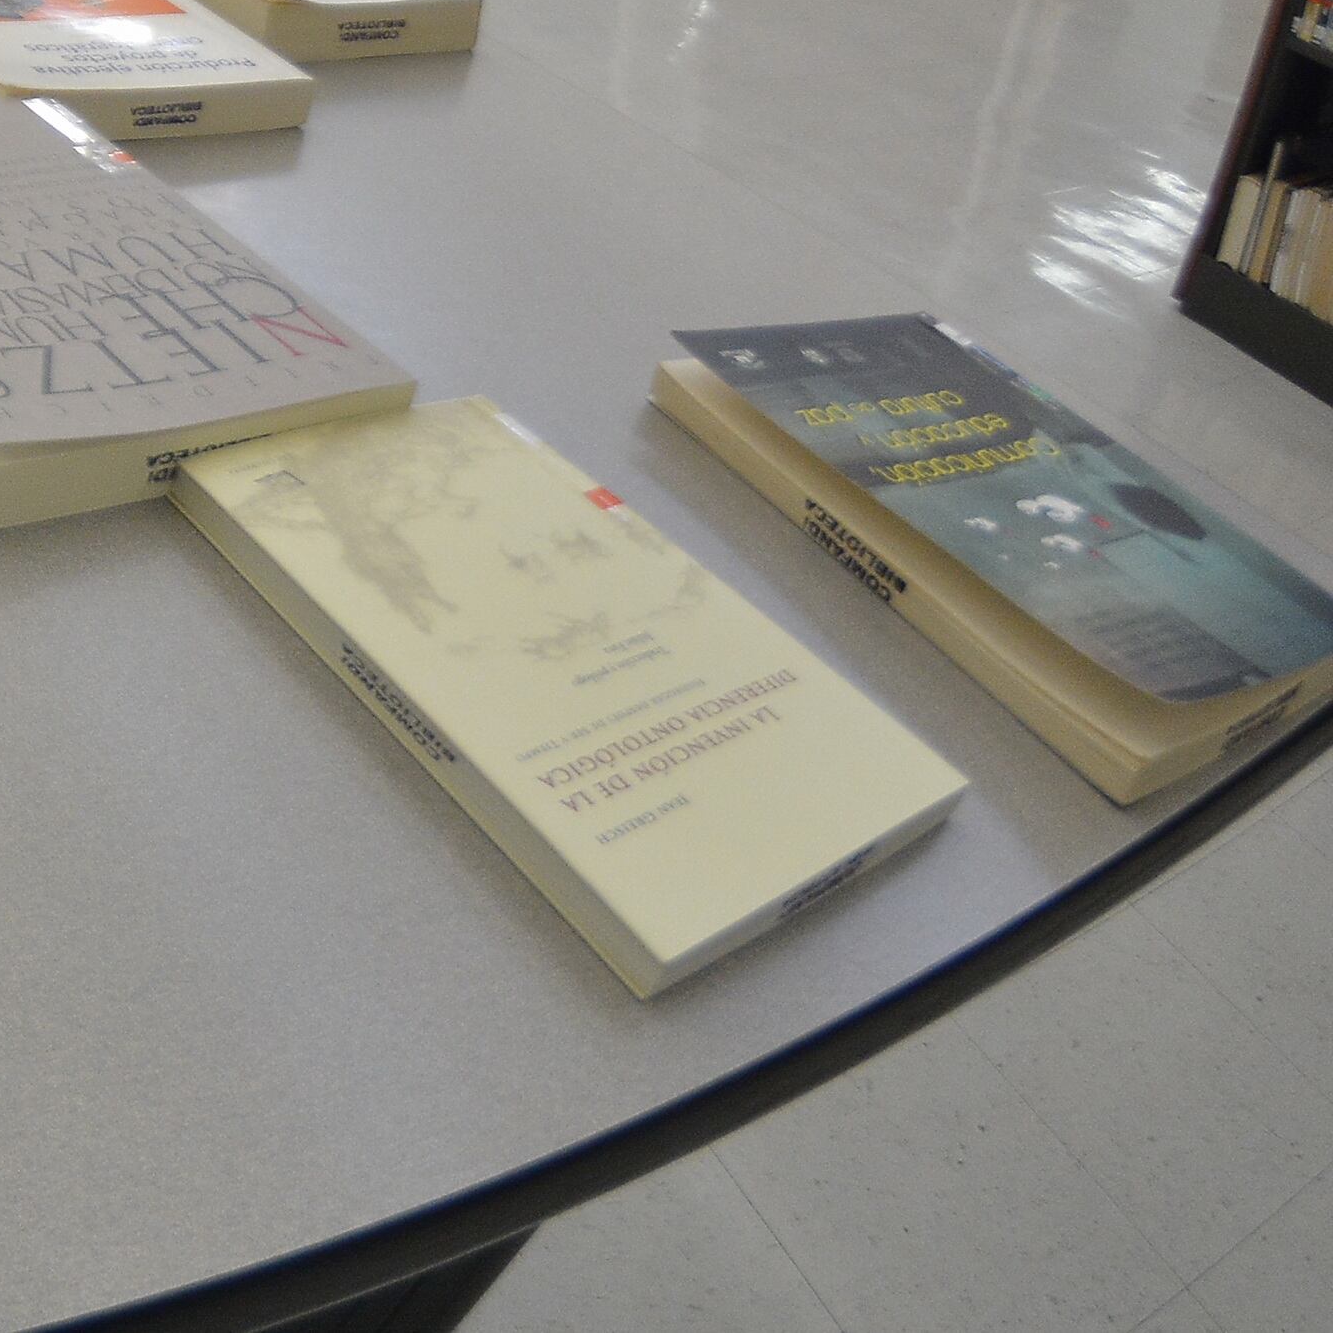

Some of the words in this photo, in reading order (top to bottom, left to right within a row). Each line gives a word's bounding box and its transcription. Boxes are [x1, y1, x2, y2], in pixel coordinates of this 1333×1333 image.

[60, 49, 167, 64] proyectos
[137, 56, 256, 75] Producción
[794, 401, 854, 428] paz
[878, 390, 965, 417] cultura
[883, 412, 1009, 453] educación
[868, 435, 1060, 487] Comunicación,
[801, 515, 893, 603] COMFANDI
[803, 496, 908, 597] BIBLIOTECA
[337, 655, 447, 769] COMFANDI
[339, 641, 459, 765] BIBLIOTECA
[683, 668, 797, 723] DIFERENCIA
[749, 704, 781, 727] LA
[536, 715, 687, 789] ONTOLÓGICA
[631, 717, 752, 781] INVENCIÓN
[557, 790, 595, 813] LA
[592, 772, 630, 799] DE
